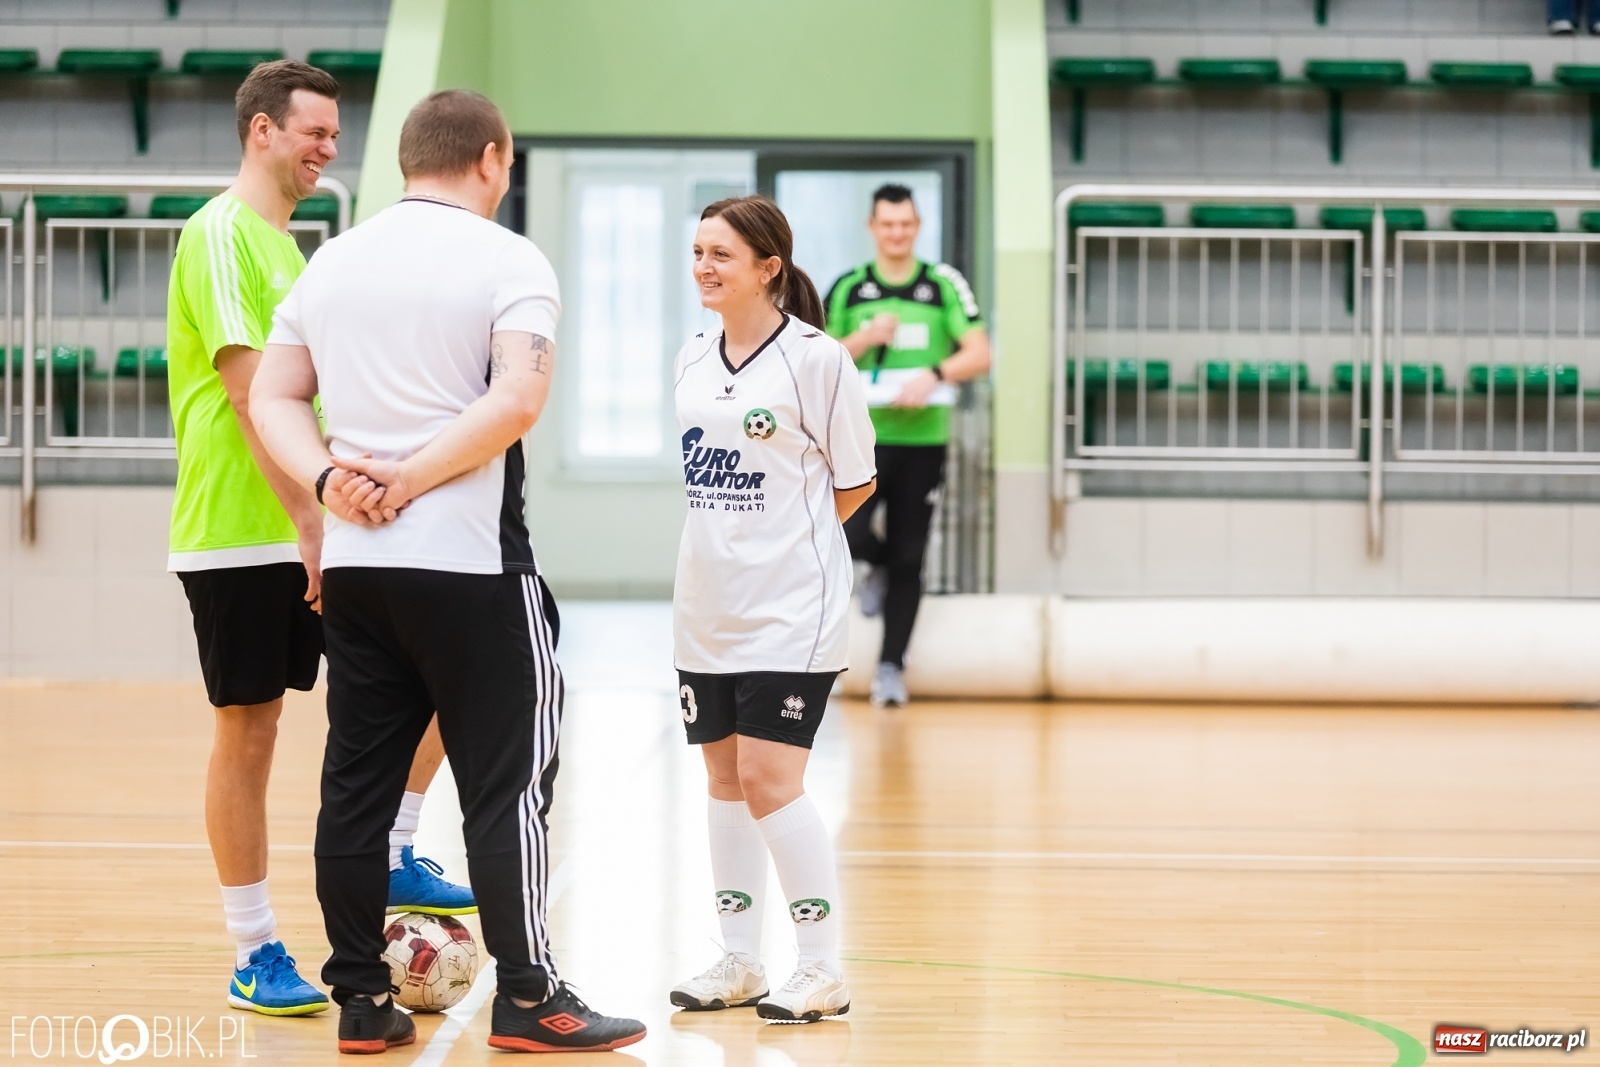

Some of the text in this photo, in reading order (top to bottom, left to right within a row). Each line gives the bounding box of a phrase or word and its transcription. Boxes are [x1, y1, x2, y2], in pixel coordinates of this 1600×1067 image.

[686, 468, 766, 490] KANTOR
[753, 493, 765, 501] 40
[689, 501, 765, 512] ERIA DUKAT)
